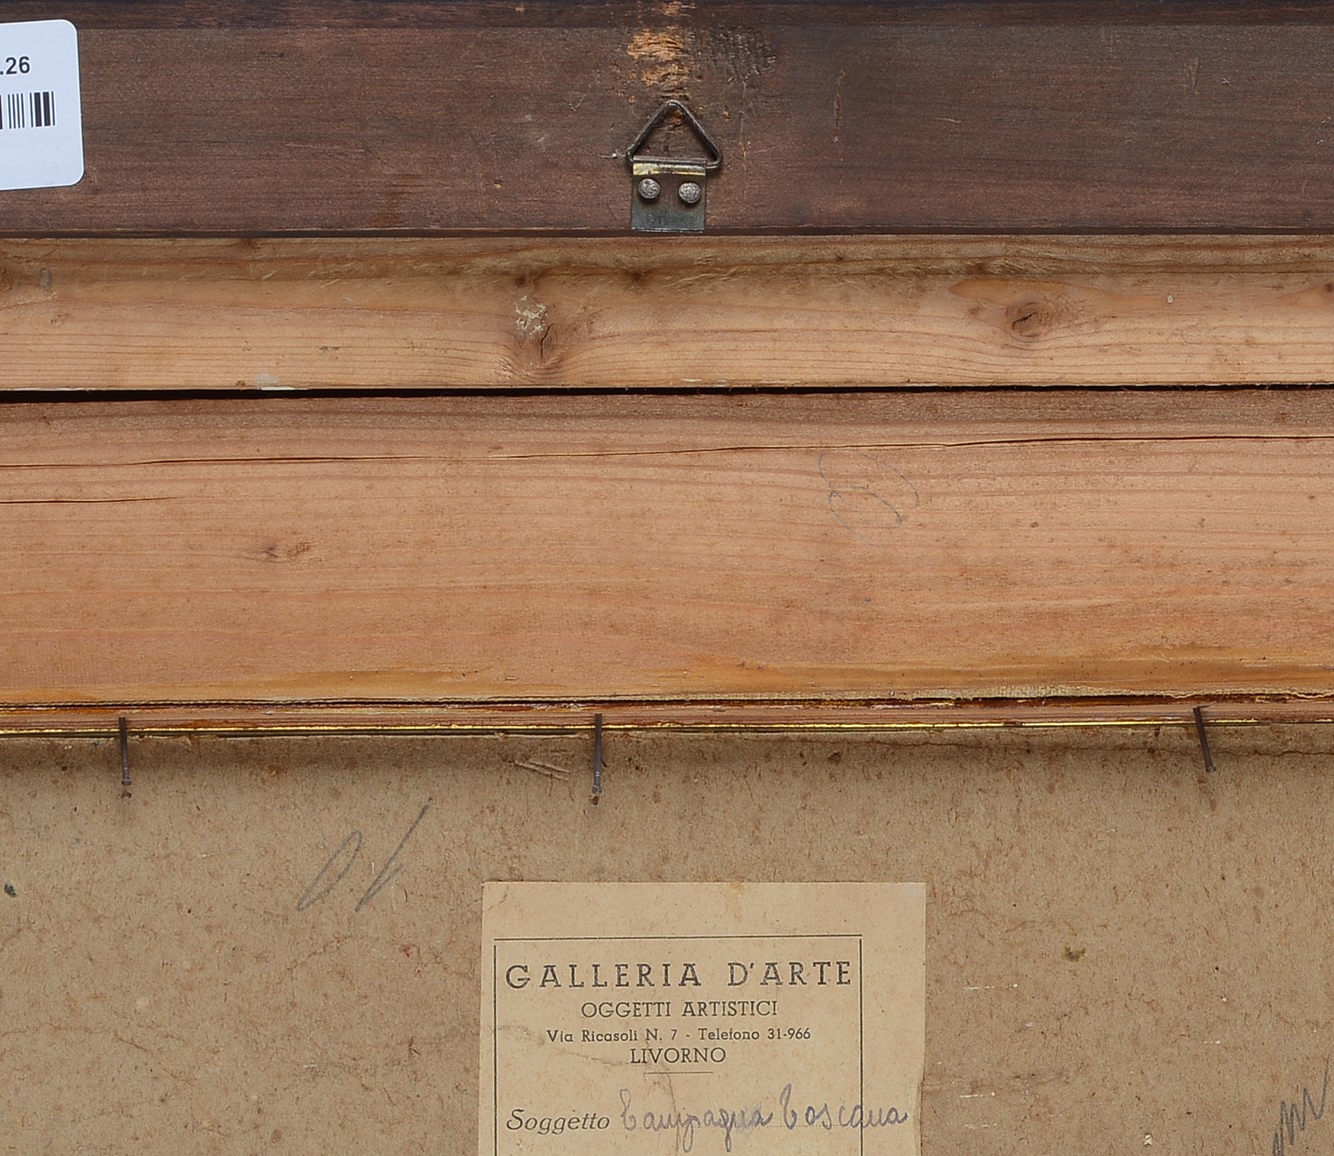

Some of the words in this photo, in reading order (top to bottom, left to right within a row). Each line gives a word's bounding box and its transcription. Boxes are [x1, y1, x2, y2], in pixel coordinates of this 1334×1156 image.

[505, 963, 702, 989] GALLERIA
[727, 961, 852, 987] D'ARTE
[580, 1001, 672, 1018] OGGETTI
[681, 1000, 778, 1017] ARTISTICI
[546, 1029, 574, 1043] Via
[581, 1029, 638, 1043] Ricasoli
[645, 1029, 663, 1042] N.
[670, 1029, 678, 1042] 7
[698, 1027, 760, 1041] Telefono
[767, 1027, 811, 1041] 31-966
[630, 1047, 727, 1064] LIVORNO
[505, 1107, 611, 1136] Soggetto
